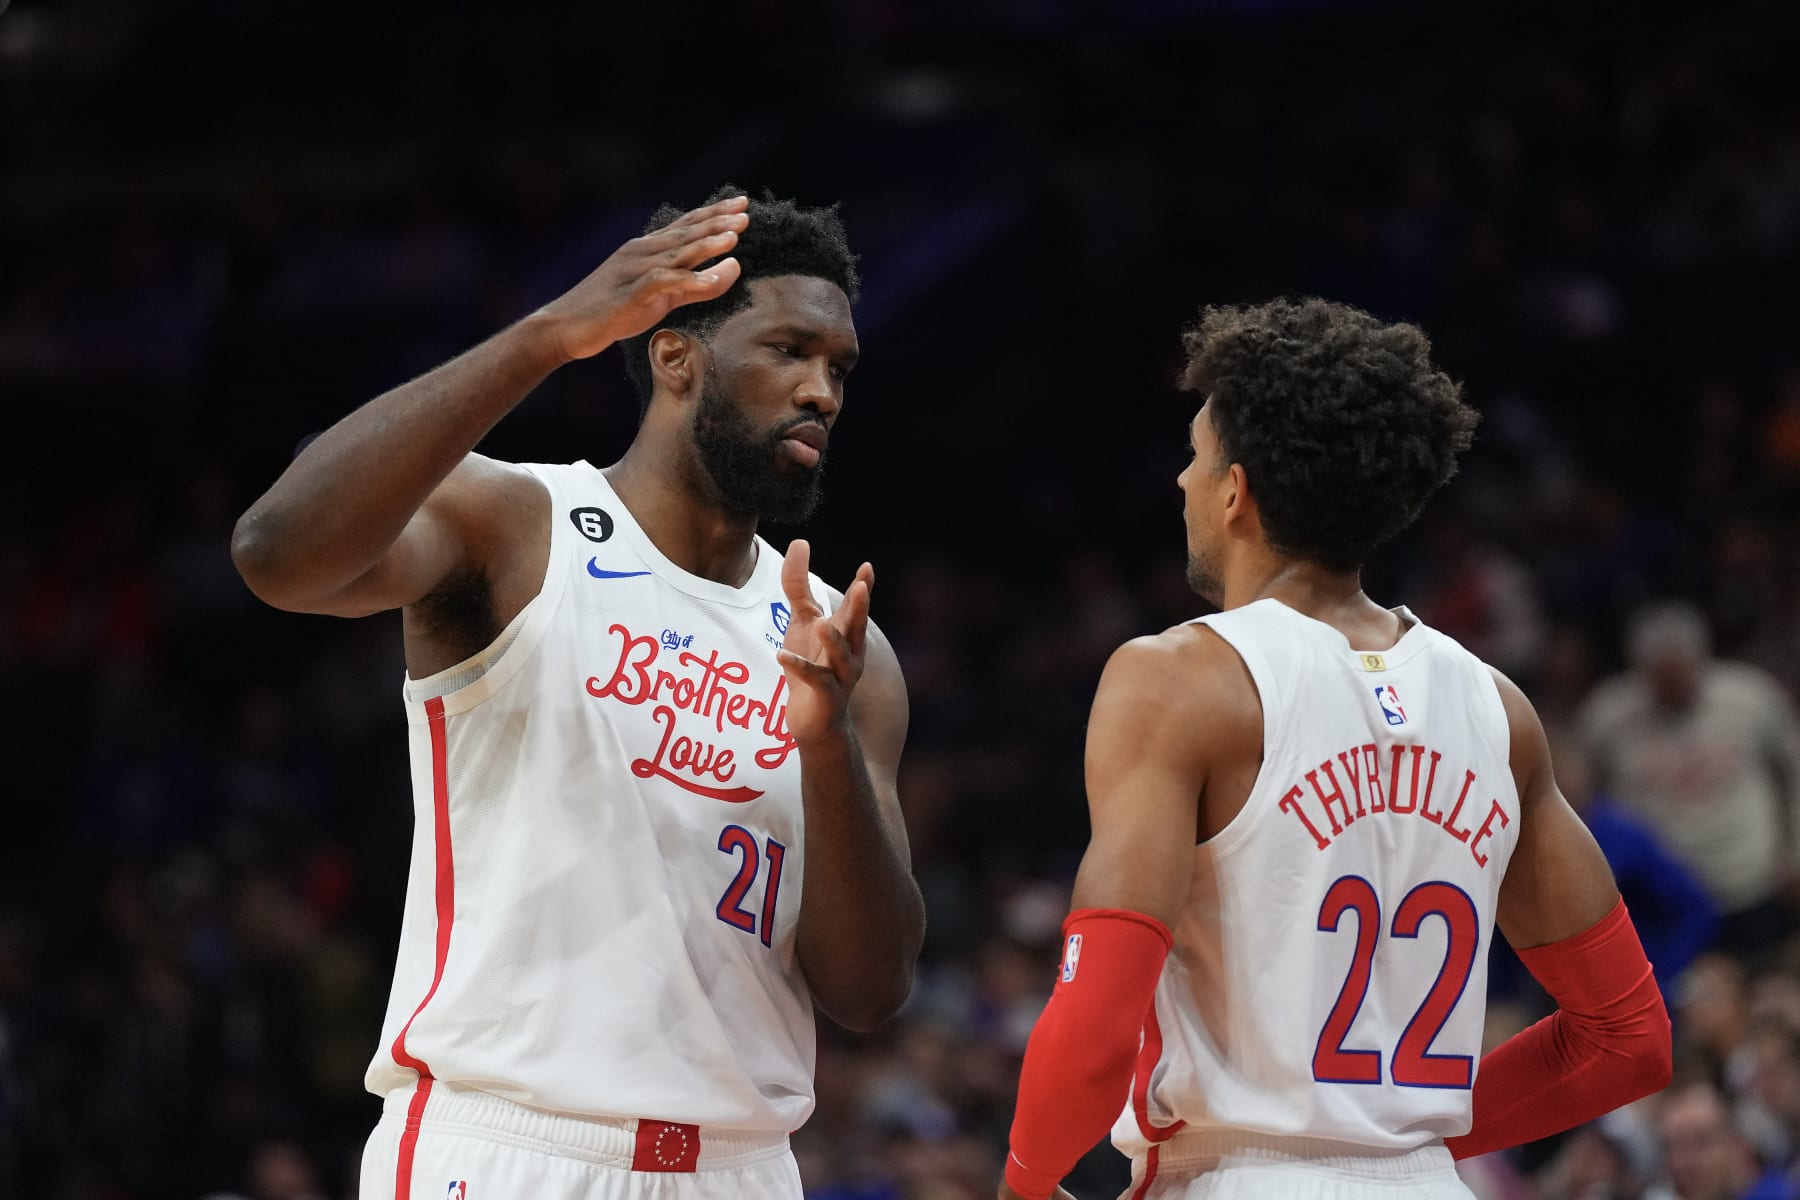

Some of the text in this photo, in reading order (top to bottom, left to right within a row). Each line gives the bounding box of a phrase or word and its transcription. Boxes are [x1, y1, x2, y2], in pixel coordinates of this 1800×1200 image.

[578, 511, 603, 539] 6
[585, 623, 798, 770] Brotherly
[660, 628, 695, 650] City of
[630, 704, 766, 803] Love
[1277, 743, 1510, 869] THYBULLE
[716, 824, 786, 949] 21
[1311, 874, 1480, 1091] 22
